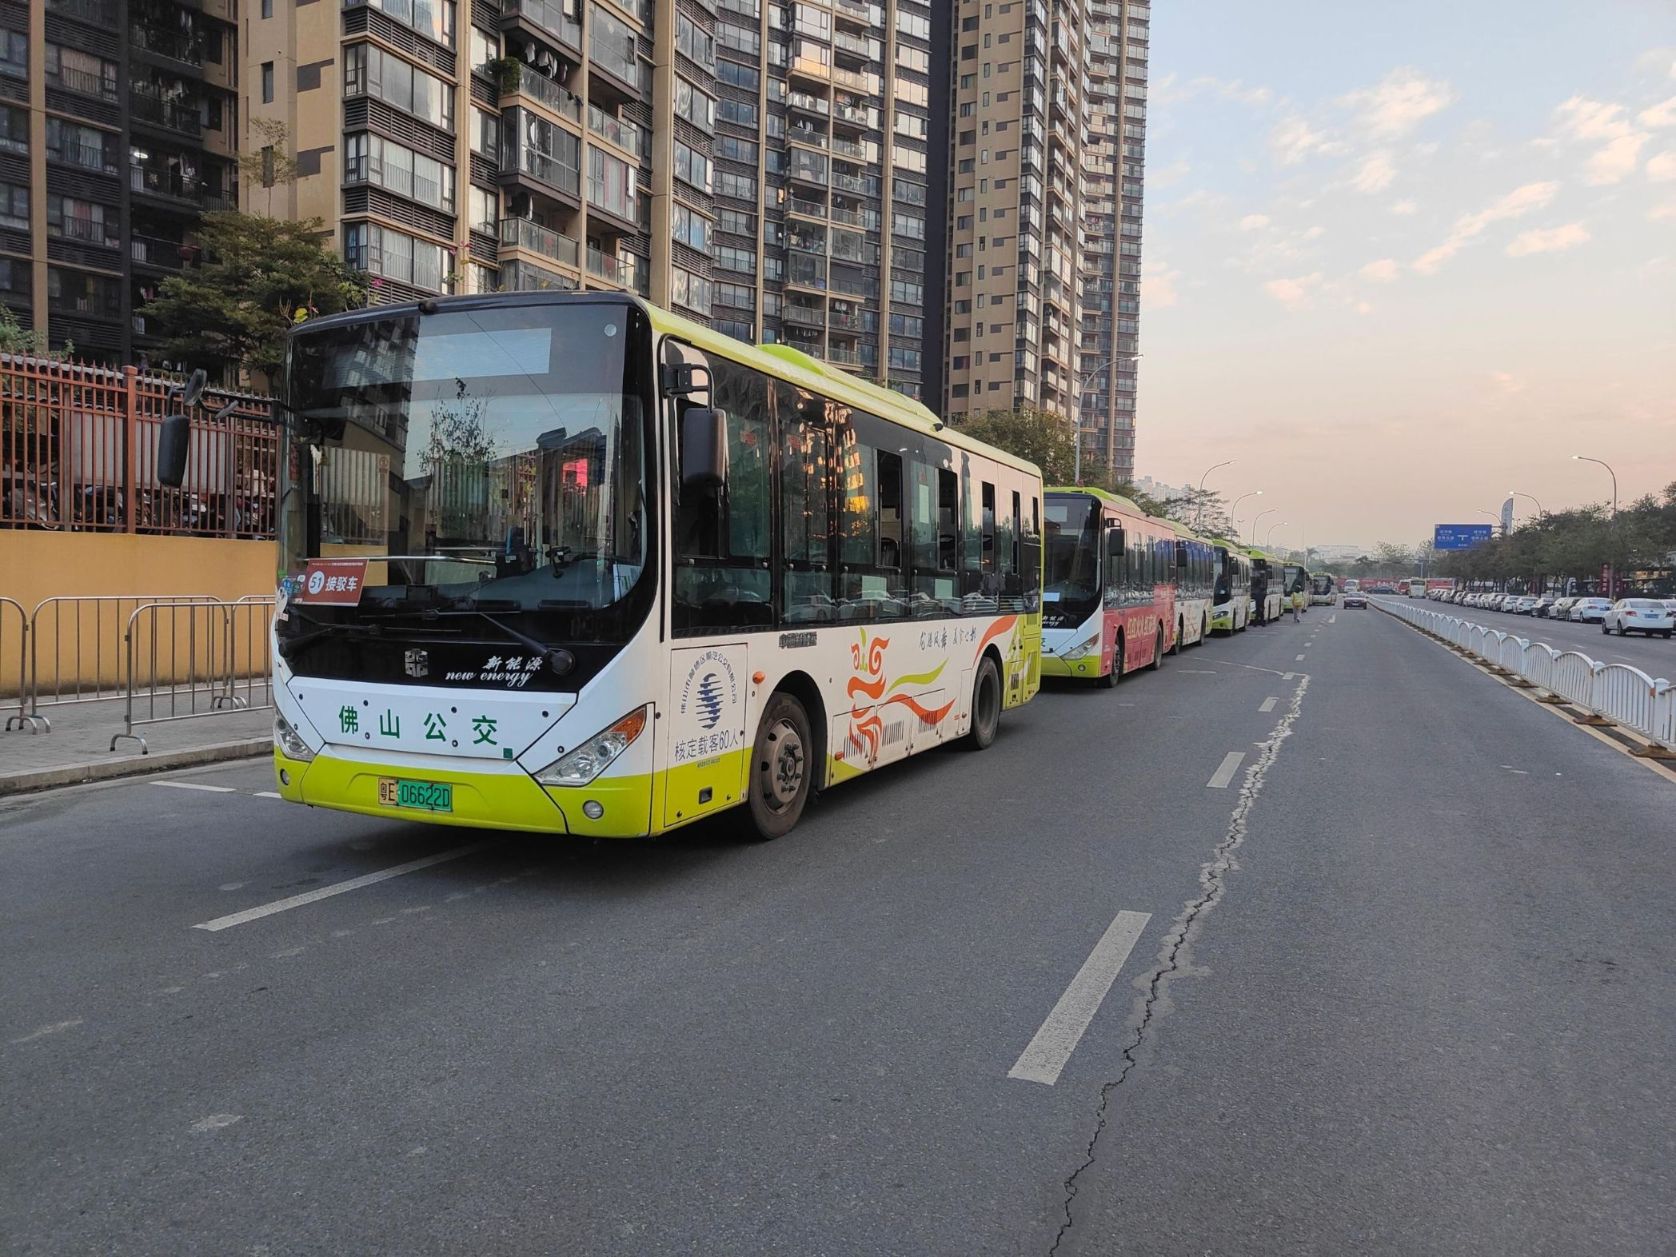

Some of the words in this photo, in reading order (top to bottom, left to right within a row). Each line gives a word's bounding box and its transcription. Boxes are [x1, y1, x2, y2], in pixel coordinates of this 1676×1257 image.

[325, 575, 359, 593] 接驳车
[482, 655, 543, 672] 新能源
[445, 671, 477, 681] new
[480, 671, 534, 687] energy
[338, 704, 498, 746] 佛山公交
[674, 728, 739, 762] 核定载客60人
